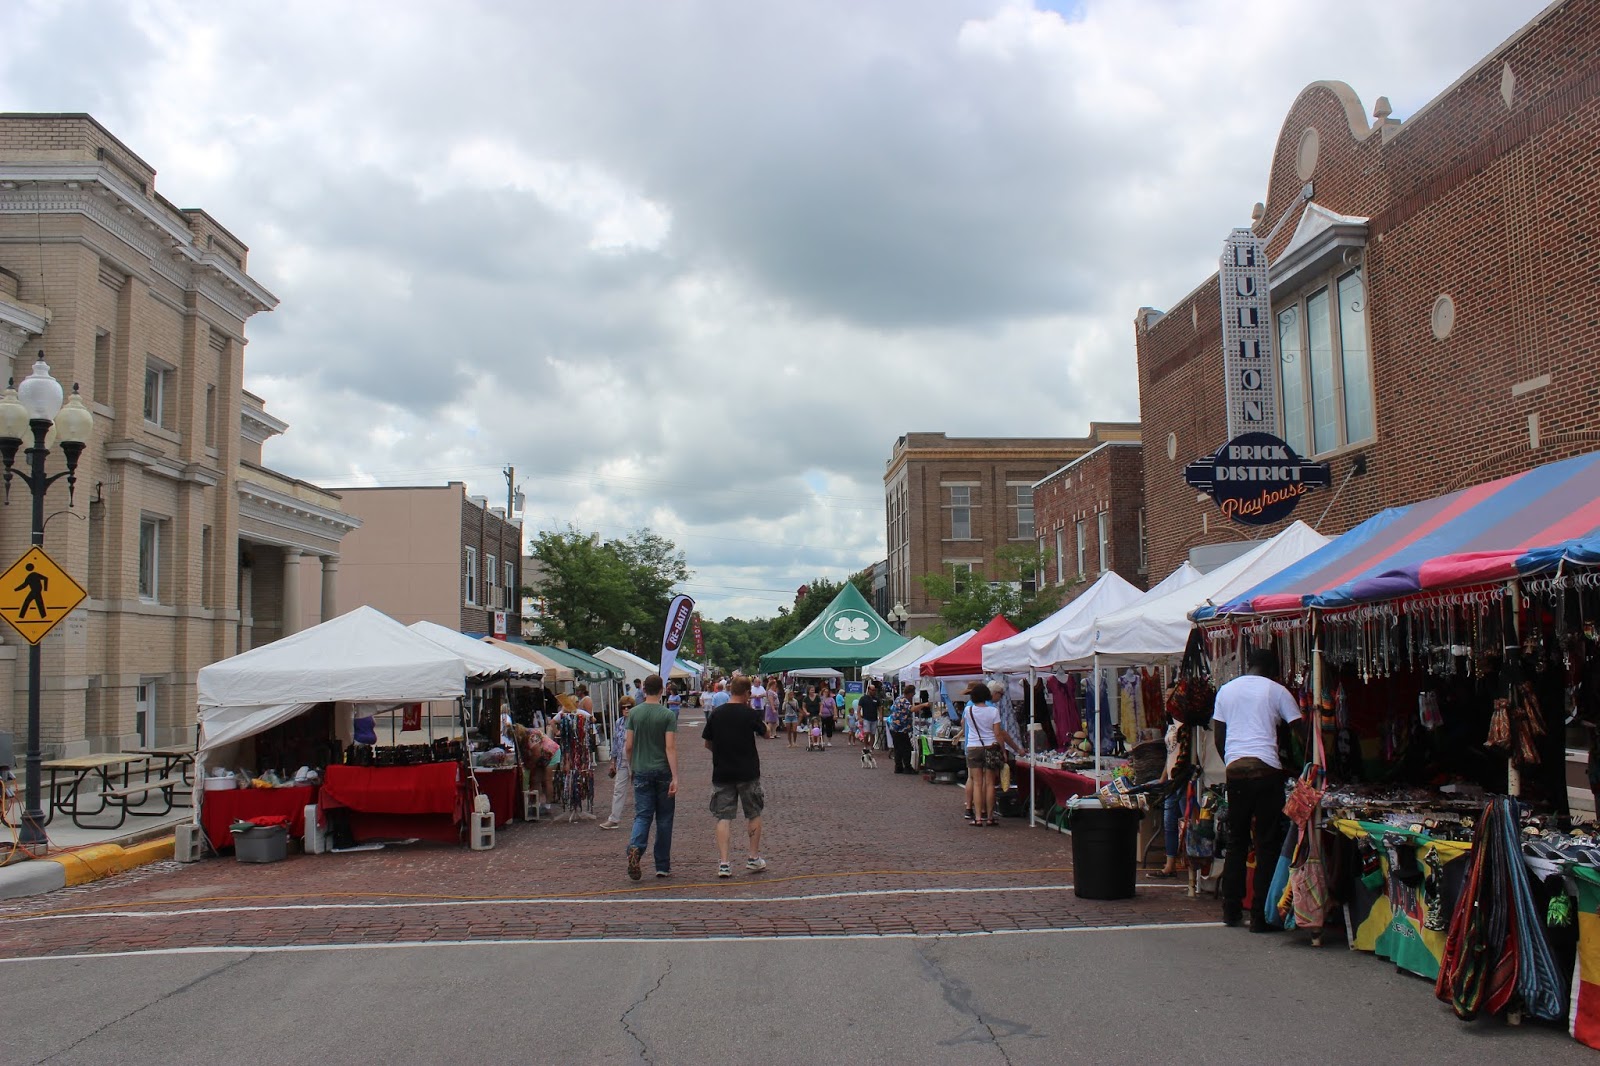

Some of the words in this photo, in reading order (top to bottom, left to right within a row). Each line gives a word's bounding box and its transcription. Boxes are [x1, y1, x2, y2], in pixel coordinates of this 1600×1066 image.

[1236, 246, 1263, 421] FULTON
[1229, 445, 1289, 460] BRICK
[1215, 466, 1302, 481] DISTRICT
[1221, 482, 1307, 519] Playhouse
[669, 606, 689, 645] RE-BATH
